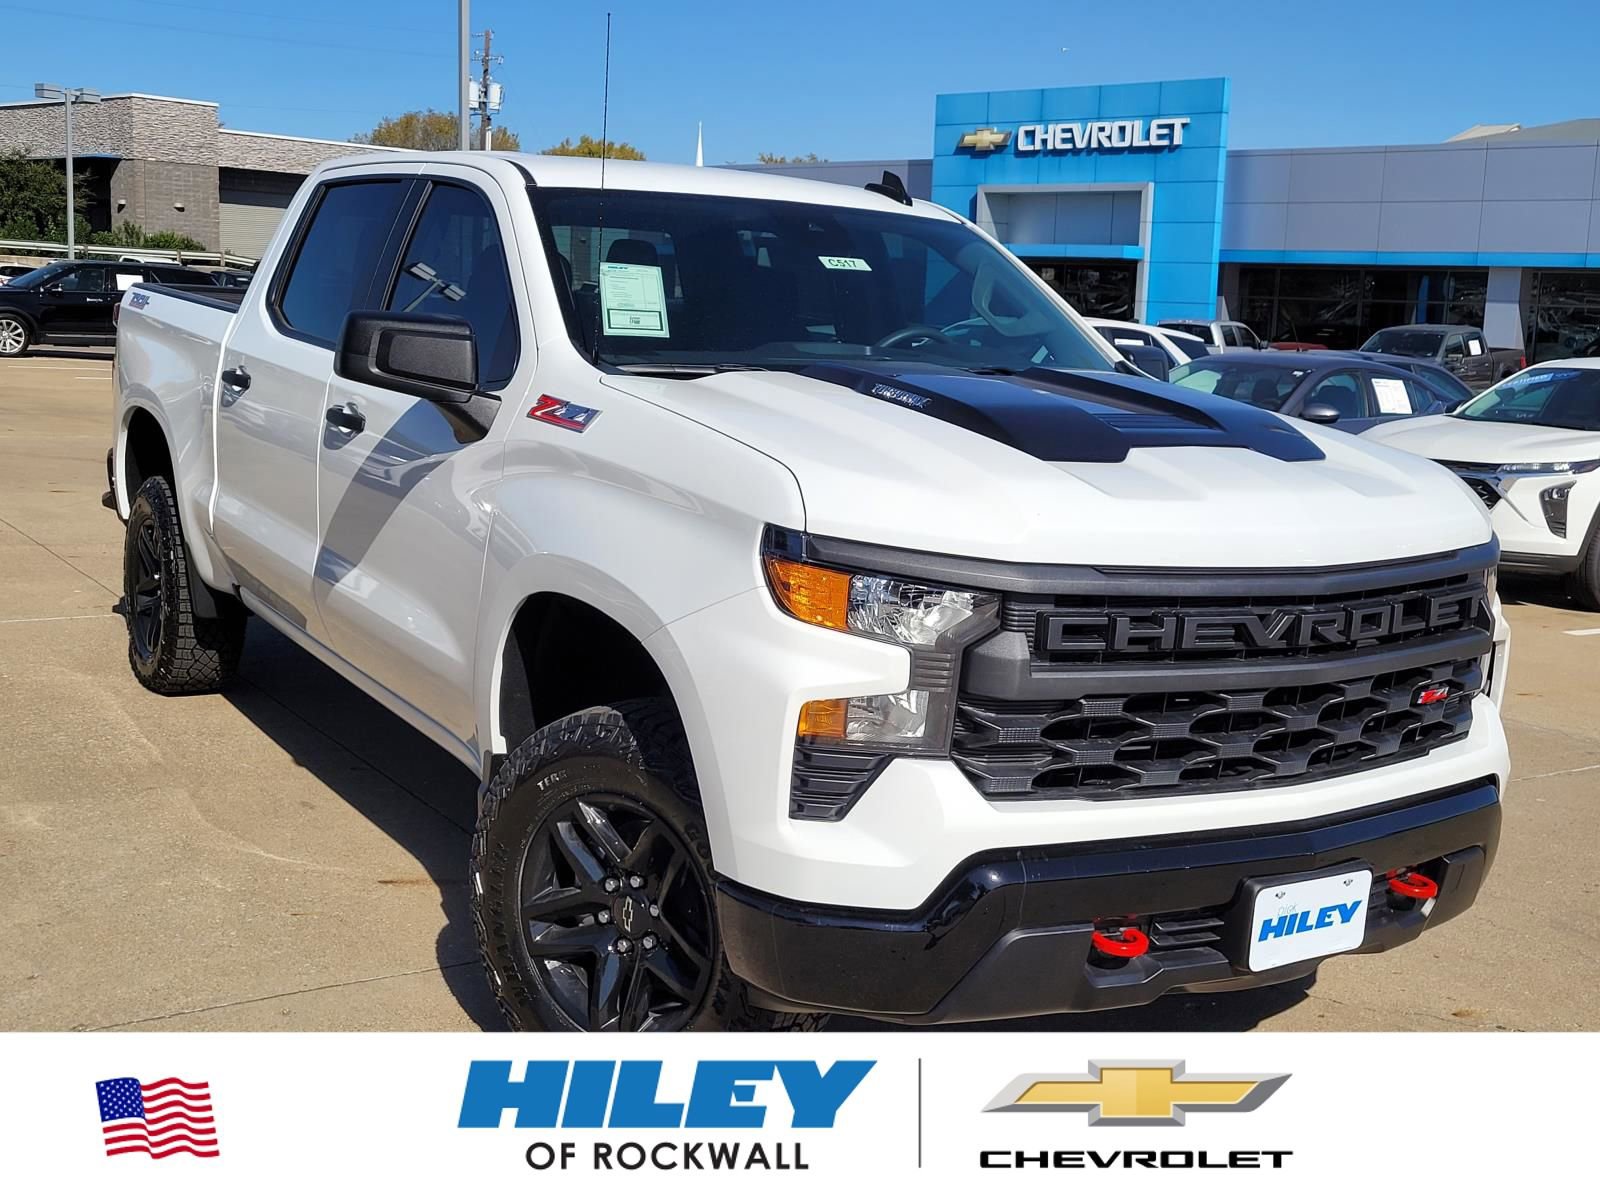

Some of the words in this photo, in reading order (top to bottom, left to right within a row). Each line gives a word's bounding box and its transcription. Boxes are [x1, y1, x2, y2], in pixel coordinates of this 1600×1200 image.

[1017, 117, 1190, 152] CHEVROLET
[827, 257, 858, 268] C517
[1046, 589, 1482, 651] CHEVROLET
[1257, 900, 1362, 943] HILEY
